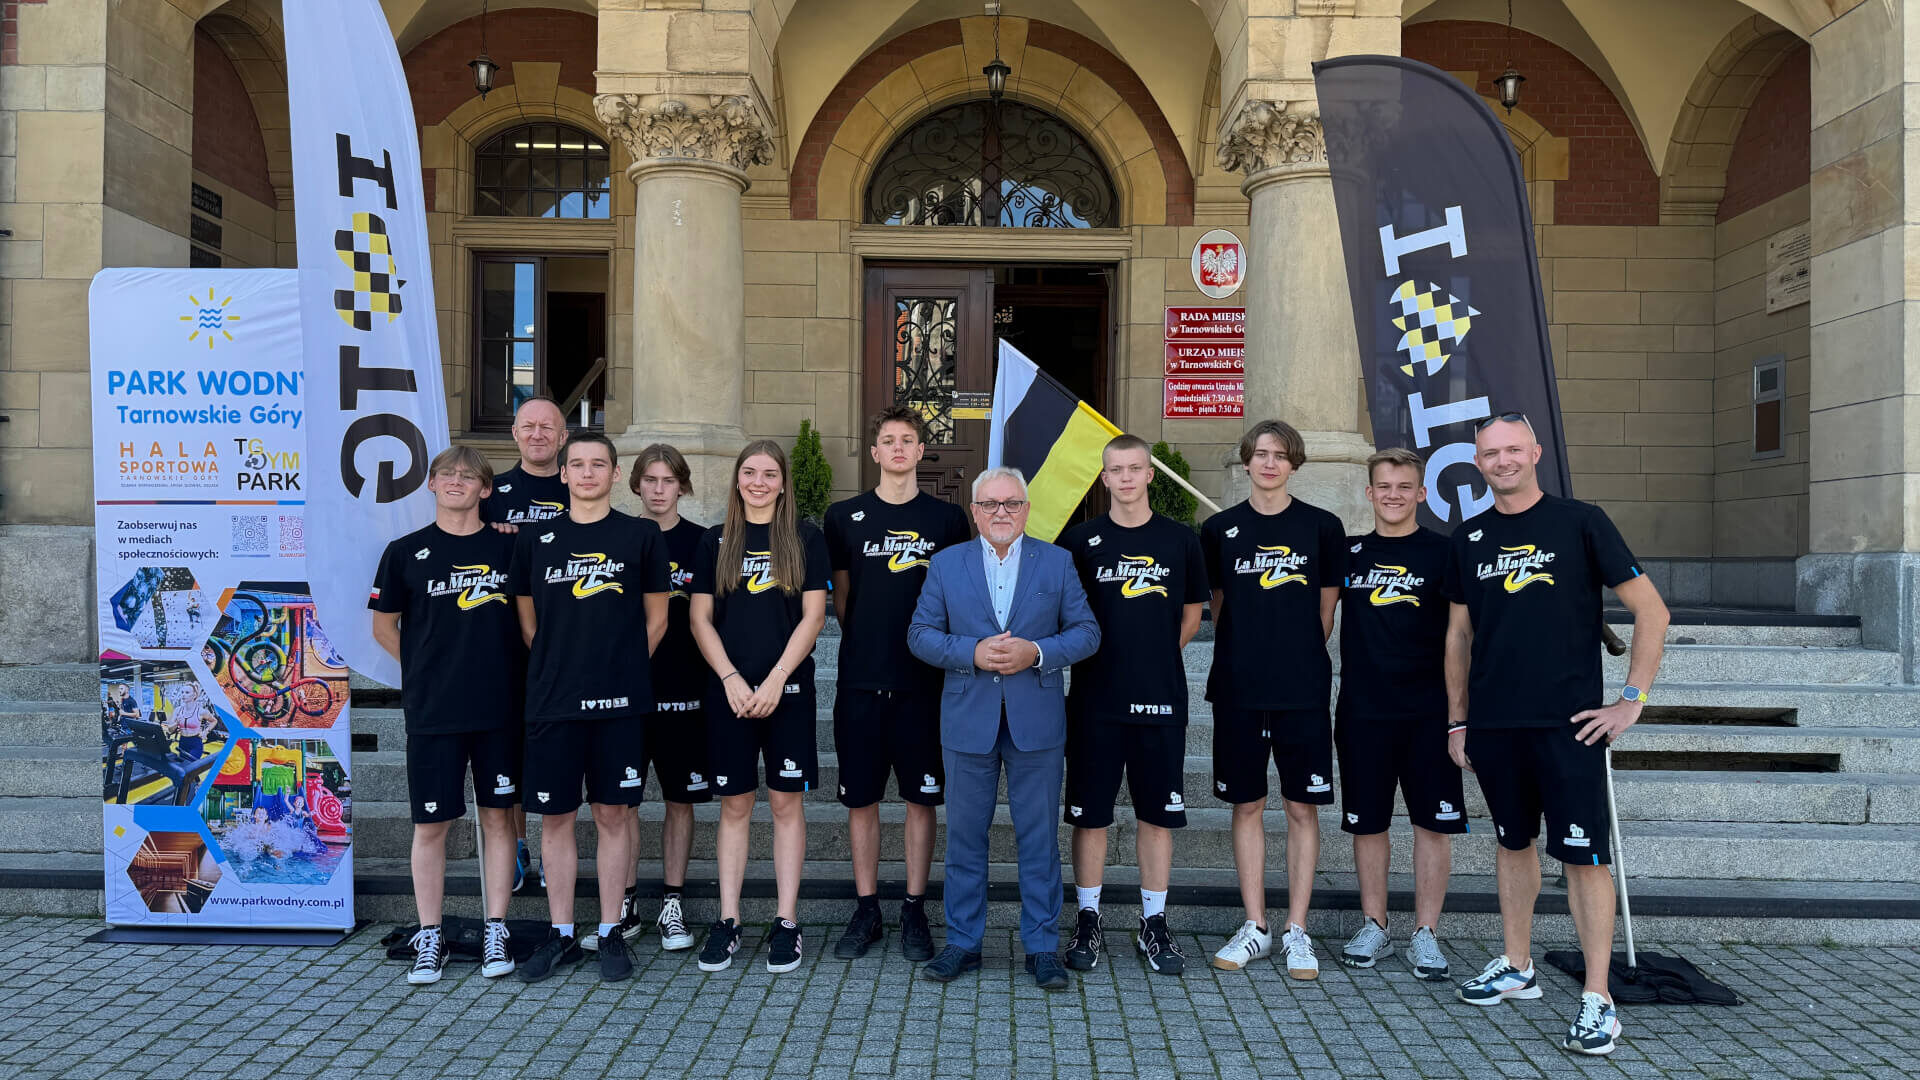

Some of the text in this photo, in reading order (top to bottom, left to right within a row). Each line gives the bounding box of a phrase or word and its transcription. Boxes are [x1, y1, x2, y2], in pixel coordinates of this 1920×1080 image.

[1180, 312, 1210, 321] RADA
[1170, 326, 1178, 334] w
[1180, 324, 1232, 334] Tarnowskich
[1178, 348, 1215, 358] URZĄD
[1180, 360, 1232, 369] Tarnowskich
[108, 370, 188, 396] PARK
[1168, 382, 1191, 392] Godziny
[1192, 383, 1215, 391] otwarcia
[1215, 383, 1236, 392] Urzędu
[1173, 394, 1211, 403] poniedziałek
[1227, 394, 1234, 402] do
[116, 402, 303, 430] Tarnowskie Góry
[1173, 405, 1194, 413] wtorek
[1198, 405, 1217, 414] piątek
[1233, 405, 1241, 413] do
[119, 440, 218, 459] HALA
[119, 460, 219, 474] SPORTOWA
[237, 472, 301, 491] PARK
[506, 508, 526, 523] La
[117, 520, 198, 532] Zaobserwuj nas
[118, 535, 173, 545] w mediach
[863, 540, 880, 554] La
[882, 537, 935, 552] Manche
[118, 549, 219, 561] społecznościowych:
[1235, 557, 1252, 571] La
[1252, 552, 1308, 569] Manche
[545, 566, 563, 582] La
[566, 558, 625, 578] Manche
[1477, 562, 1494, 578] La
[1494, 549, 1555, 573] Manche
[1095, 563, 1170, 579] La Manche
[426, 579, 447, 594] La
[449, 569, 509, 590] Manche
[1364, 572, 1425, 587] Manche
[210, 895, 345, 909] www.parkwodny.com.pl
